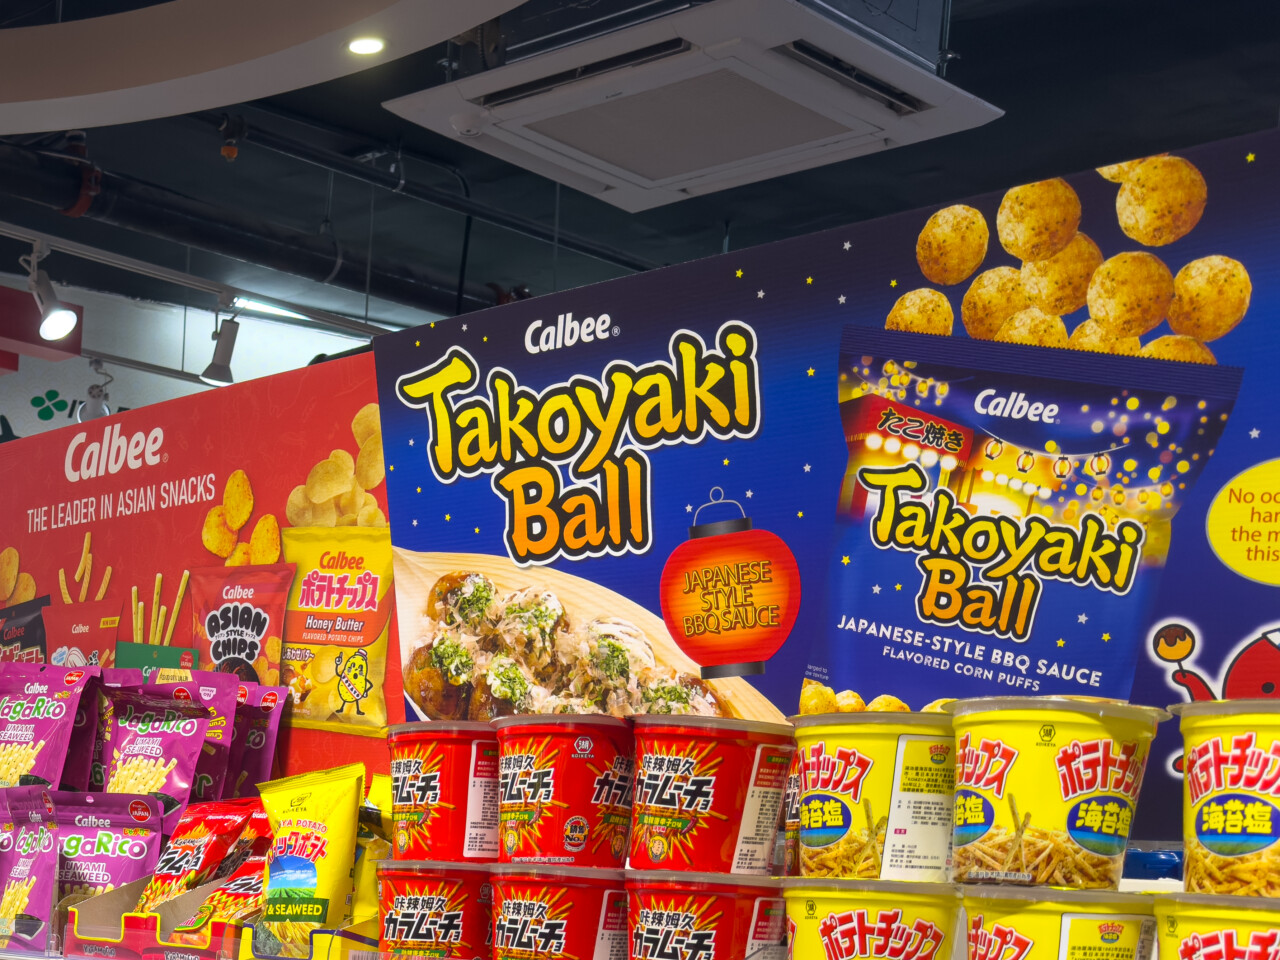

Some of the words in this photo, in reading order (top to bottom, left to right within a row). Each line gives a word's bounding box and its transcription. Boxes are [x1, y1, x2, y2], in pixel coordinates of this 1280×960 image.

[399, 322, 758, 482] Takoyaki
[876, 406, 966, 453] たこ焼き
[27, 508, 48, 533] THE
[50, 501, 97, 530] LEADER
[100, 499, 113, 520] IN
[116, 487, 156, 517] ASIAN
[160, 473, 216, 508] SNACKS
[494, 447, 650, 567] Ball
[858, 462, 1144, 595] Takoyaki
[1246, 545, 1280, 561] this
[683, 560, 772, 594] JAPANESE
[700, 586, 754, 611] STYLE
[916, 553, 1041, 641] Ball
[206, 603, 269, 636] ASIAN
[305, 615, 332, 632] Honey
[334, 617, 364, 632] Butter
[225, 629, 245, 639] STYLE
[302, 633, 325, 642] FLAVORED
[327, 634, 347, 642] POTATO
[348, 635, 364, 644] CHIPS
[211, 636, 261, 664] CHIPS
[837, 615, 987, 661] JAPANESE-STYLE
[990, 648, 1031, 670] BBQ
[1035, 657, 1102, 687] SAUCE
[882, 645, 951, 674] FLAVORED
[954, 662, 994, 681] CORN
[997, 670, 1040, 692] PUFFS
[5, 724, 35, 733] UMAMI
[126, 744, 163, 757] SEAWEED
[75, 814, 110, 828] Calbee
[132, 809, 149, 817] JAPAN
[296, 819, 328, 833] POTATO
[65, 861, 106, 874] UMAMI
